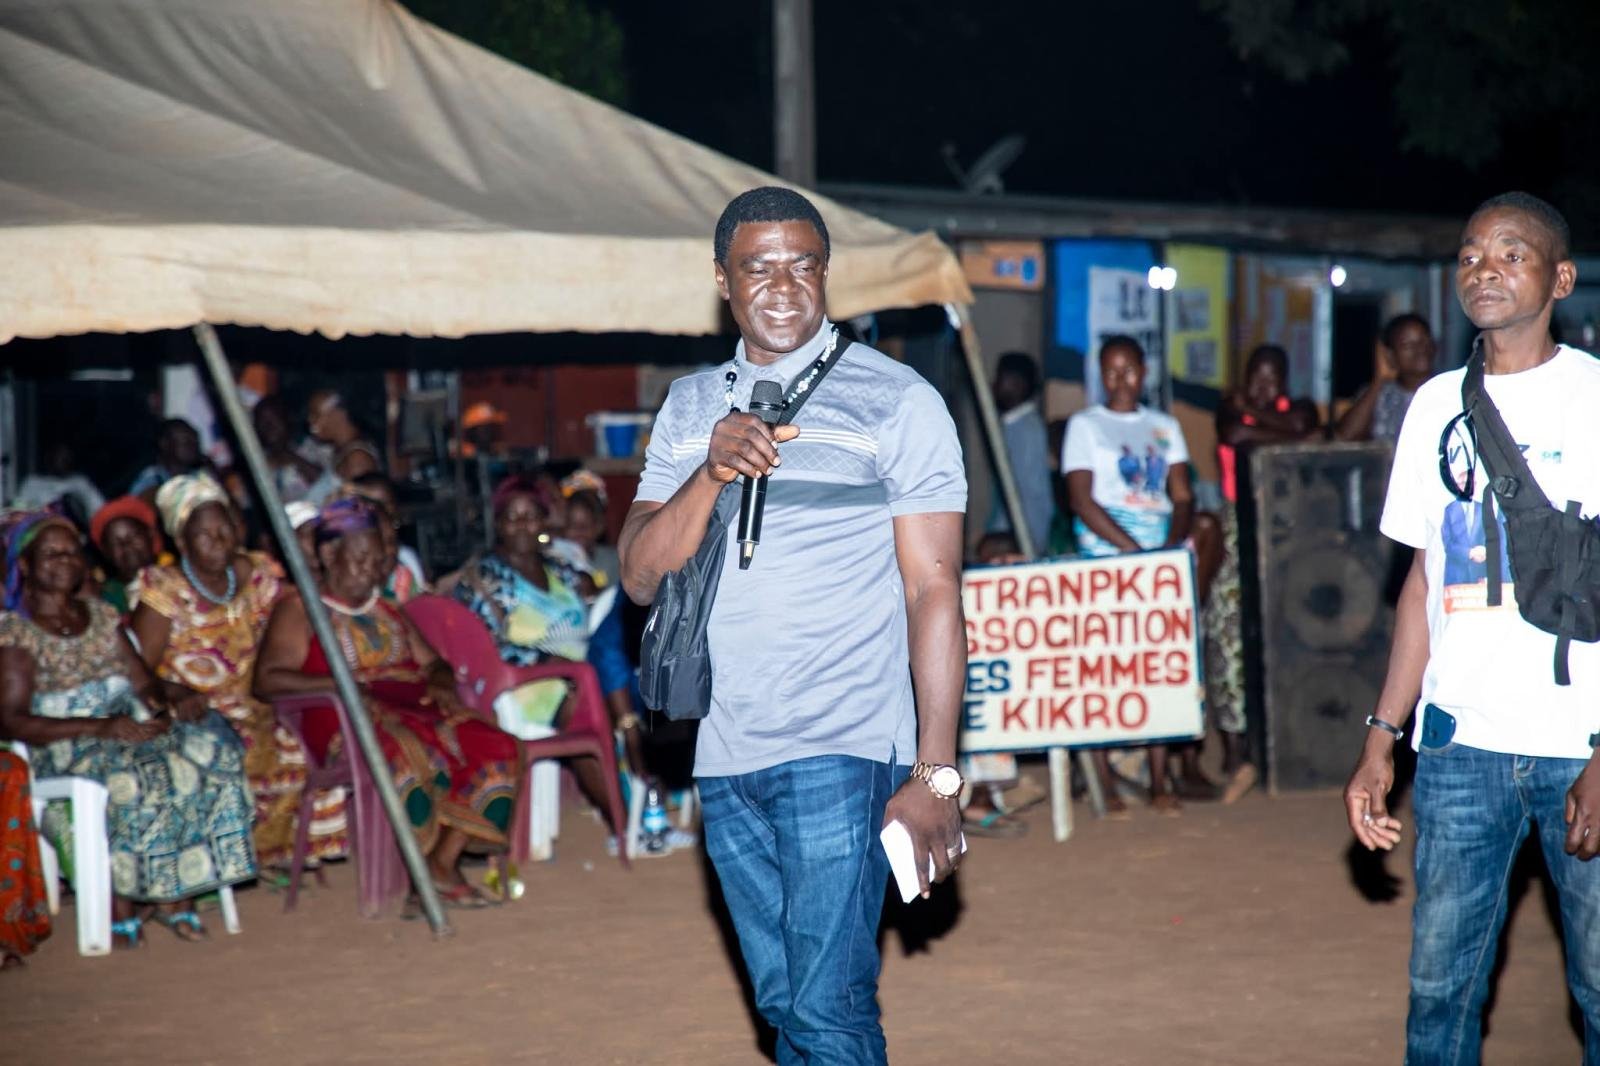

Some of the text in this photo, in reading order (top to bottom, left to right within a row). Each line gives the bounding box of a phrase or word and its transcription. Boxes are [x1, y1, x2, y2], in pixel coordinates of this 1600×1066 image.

[966, 608, 1192, 655] SSOCIATION
[966, 650, 1190, 693] ES FEMMES
[964, 692, 1149, 731] E KIKRO
